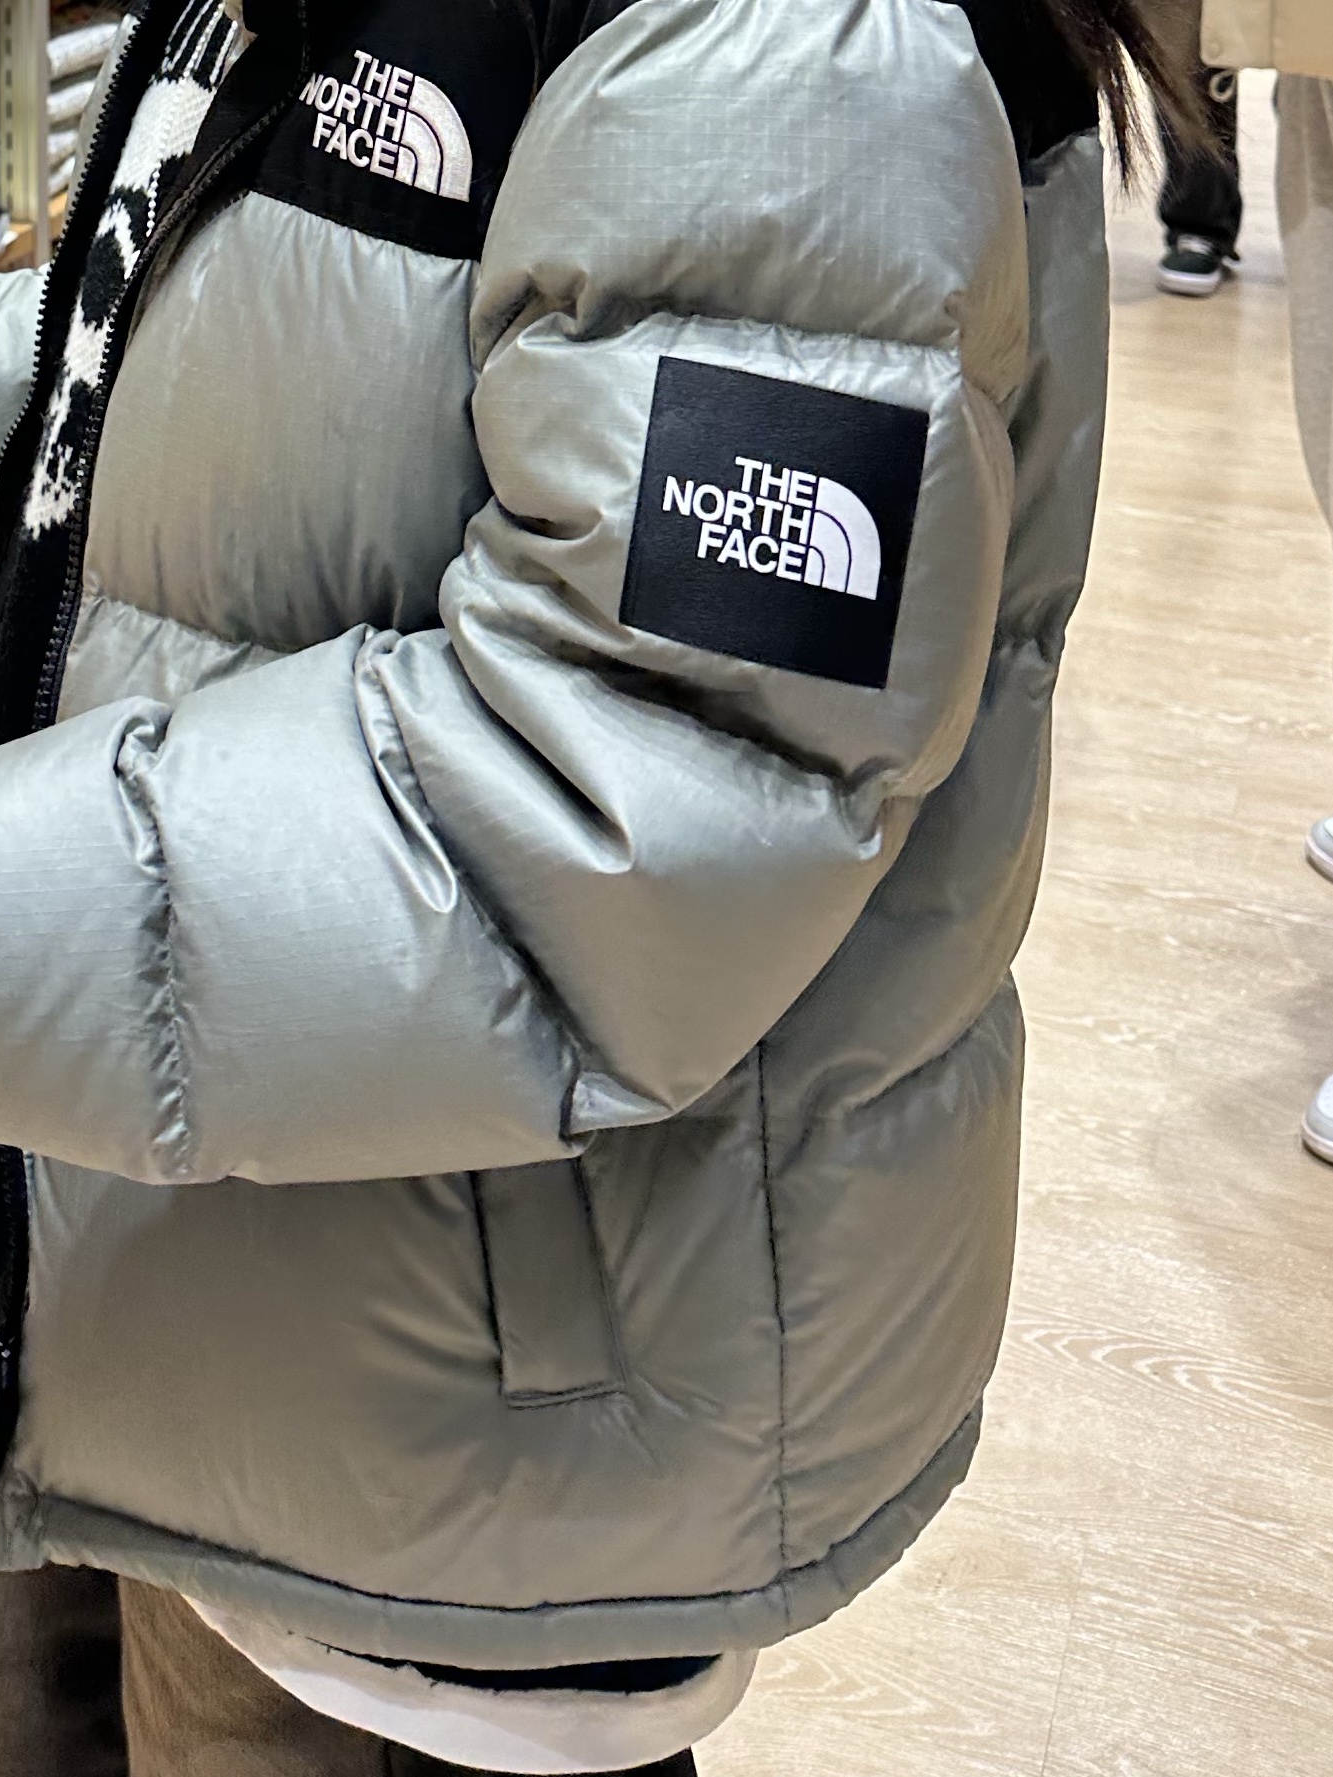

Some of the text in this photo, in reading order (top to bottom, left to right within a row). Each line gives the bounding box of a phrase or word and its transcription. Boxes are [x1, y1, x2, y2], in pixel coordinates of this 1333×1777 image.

[299, 72, 406, 143] NORTH
[351, 49, 414, 108] THE
[312, 112, 400, 179] FACE
[662, 475, 811, 545] NORTH
[735, 456, 817, 509] THE
[697, 522, 806, 582] FACE
